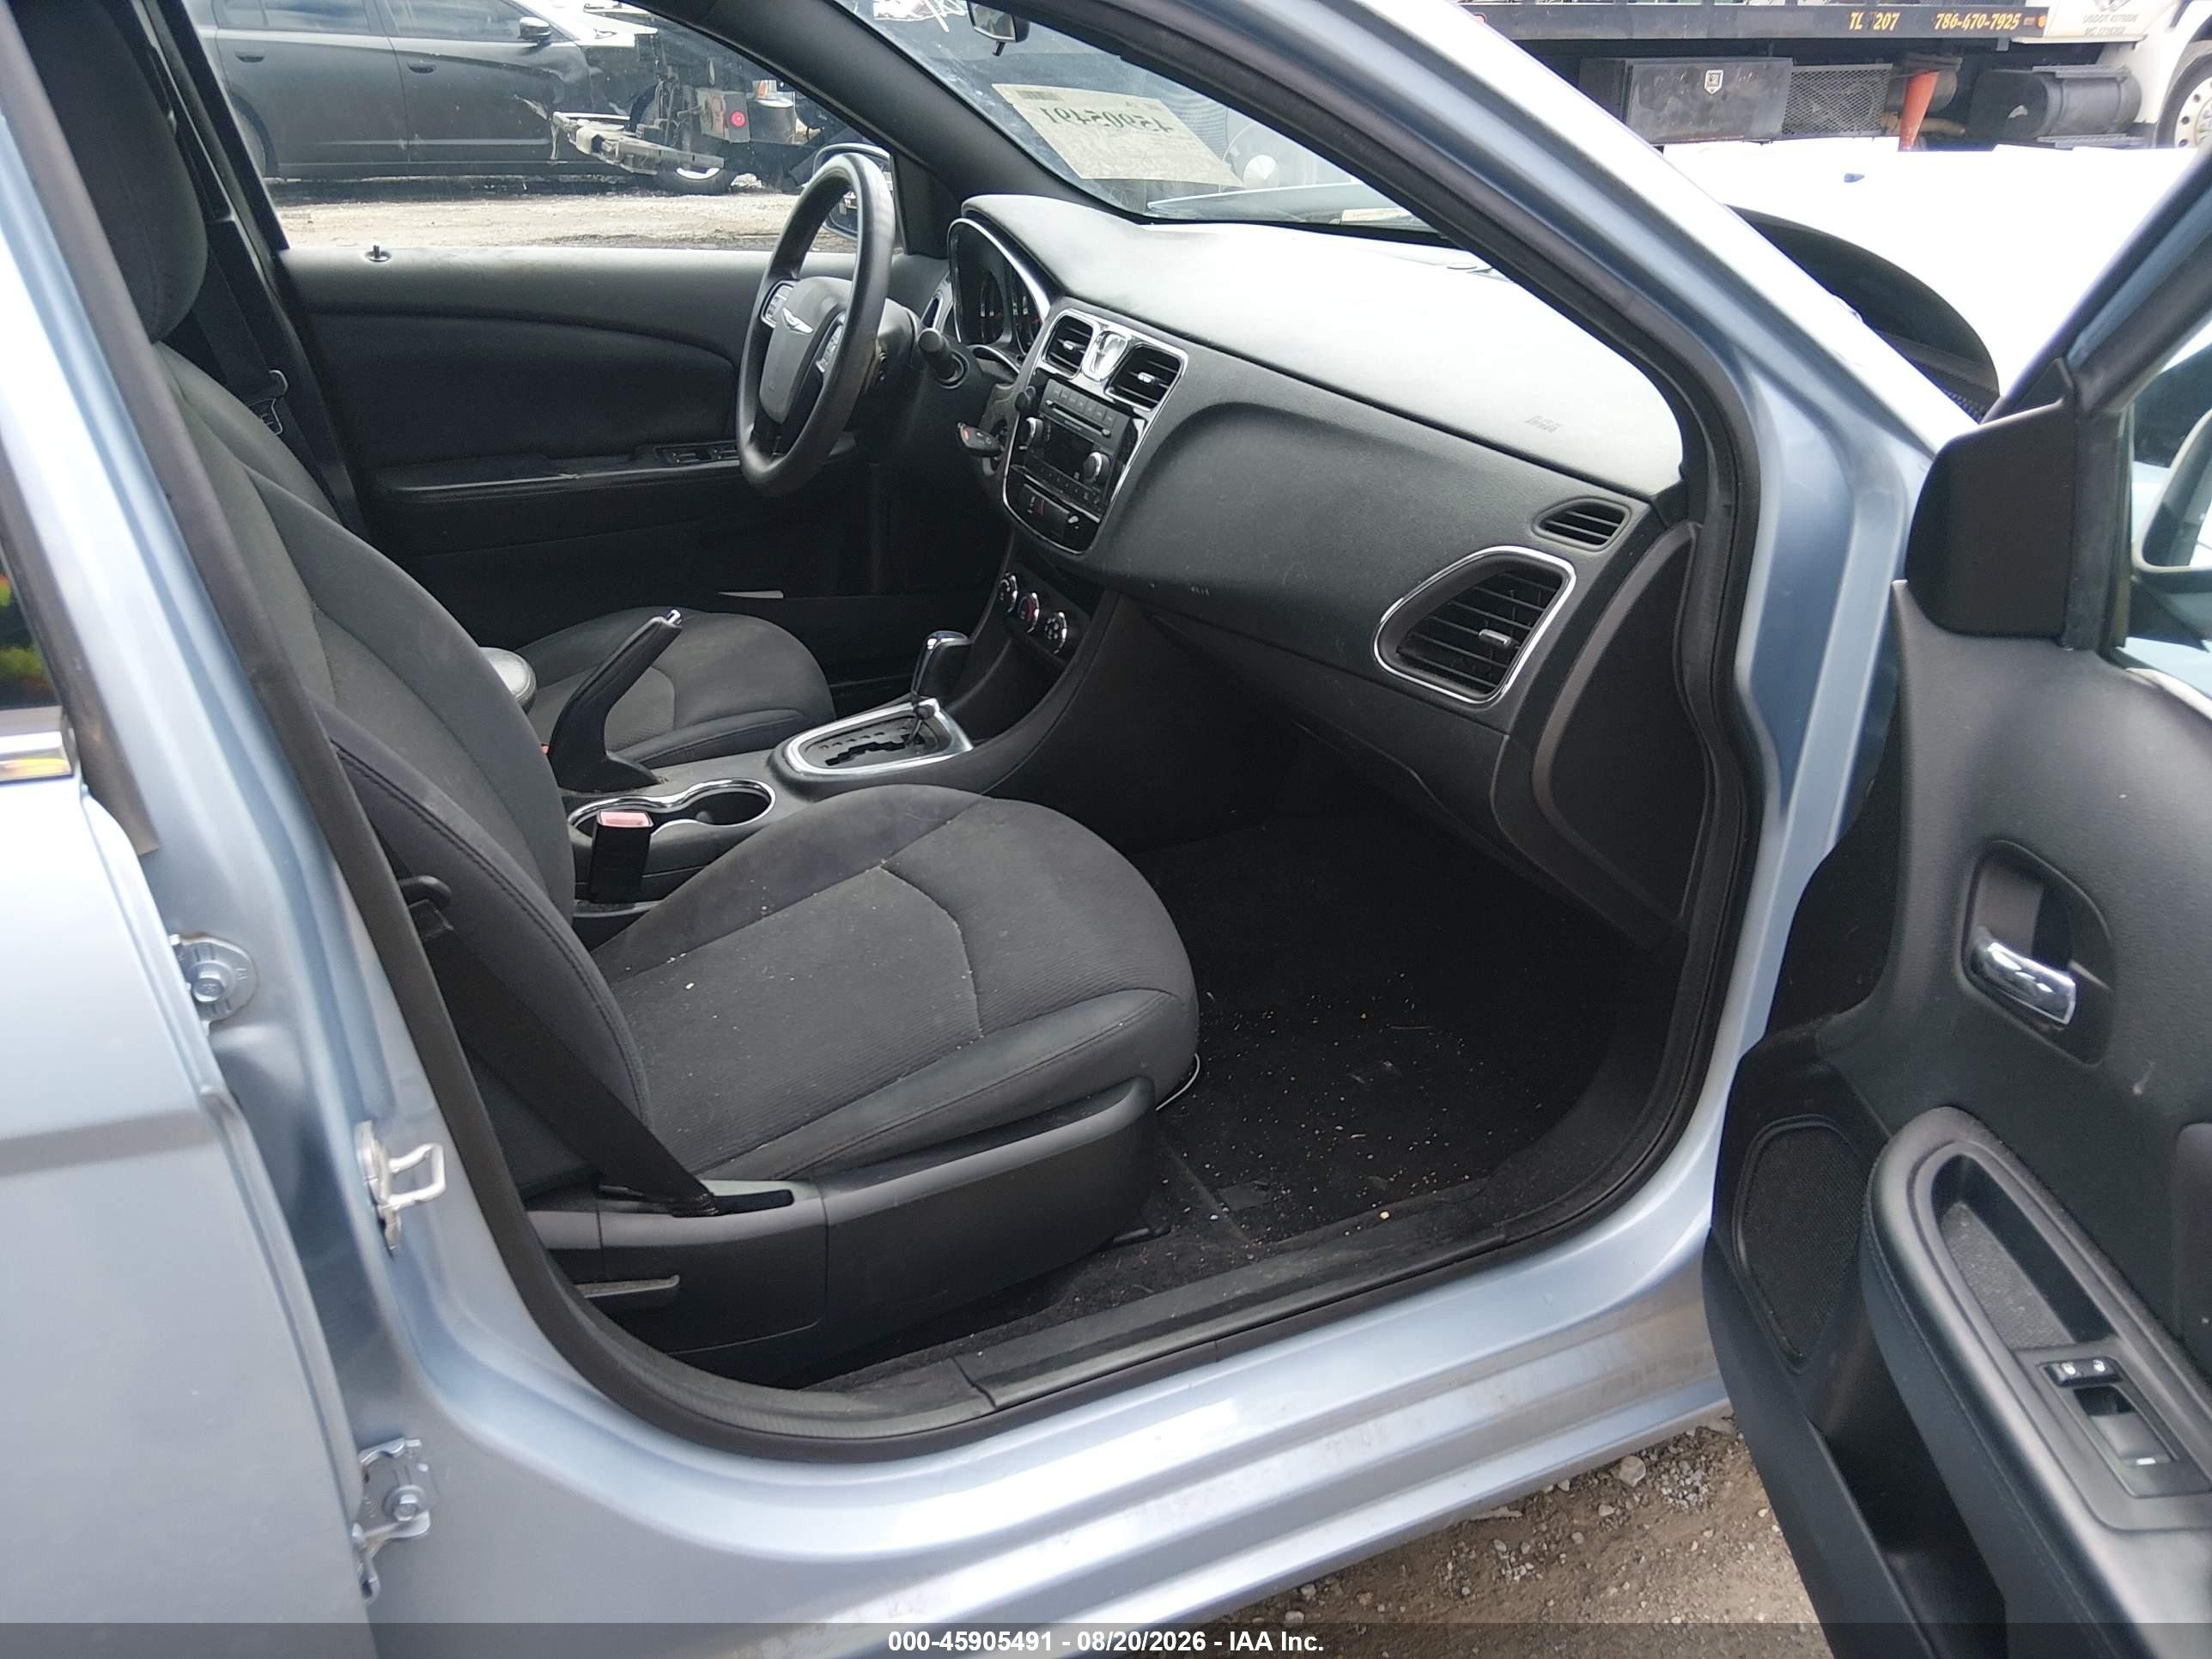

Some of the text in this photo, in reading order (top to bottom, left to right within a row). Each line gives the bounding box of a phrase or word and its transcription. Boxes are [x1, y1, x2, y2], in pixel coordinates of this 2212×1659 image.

[1849, 11, 1901, 31] TL 207
[1934, 12, 2022, 31] 786-470-7925
